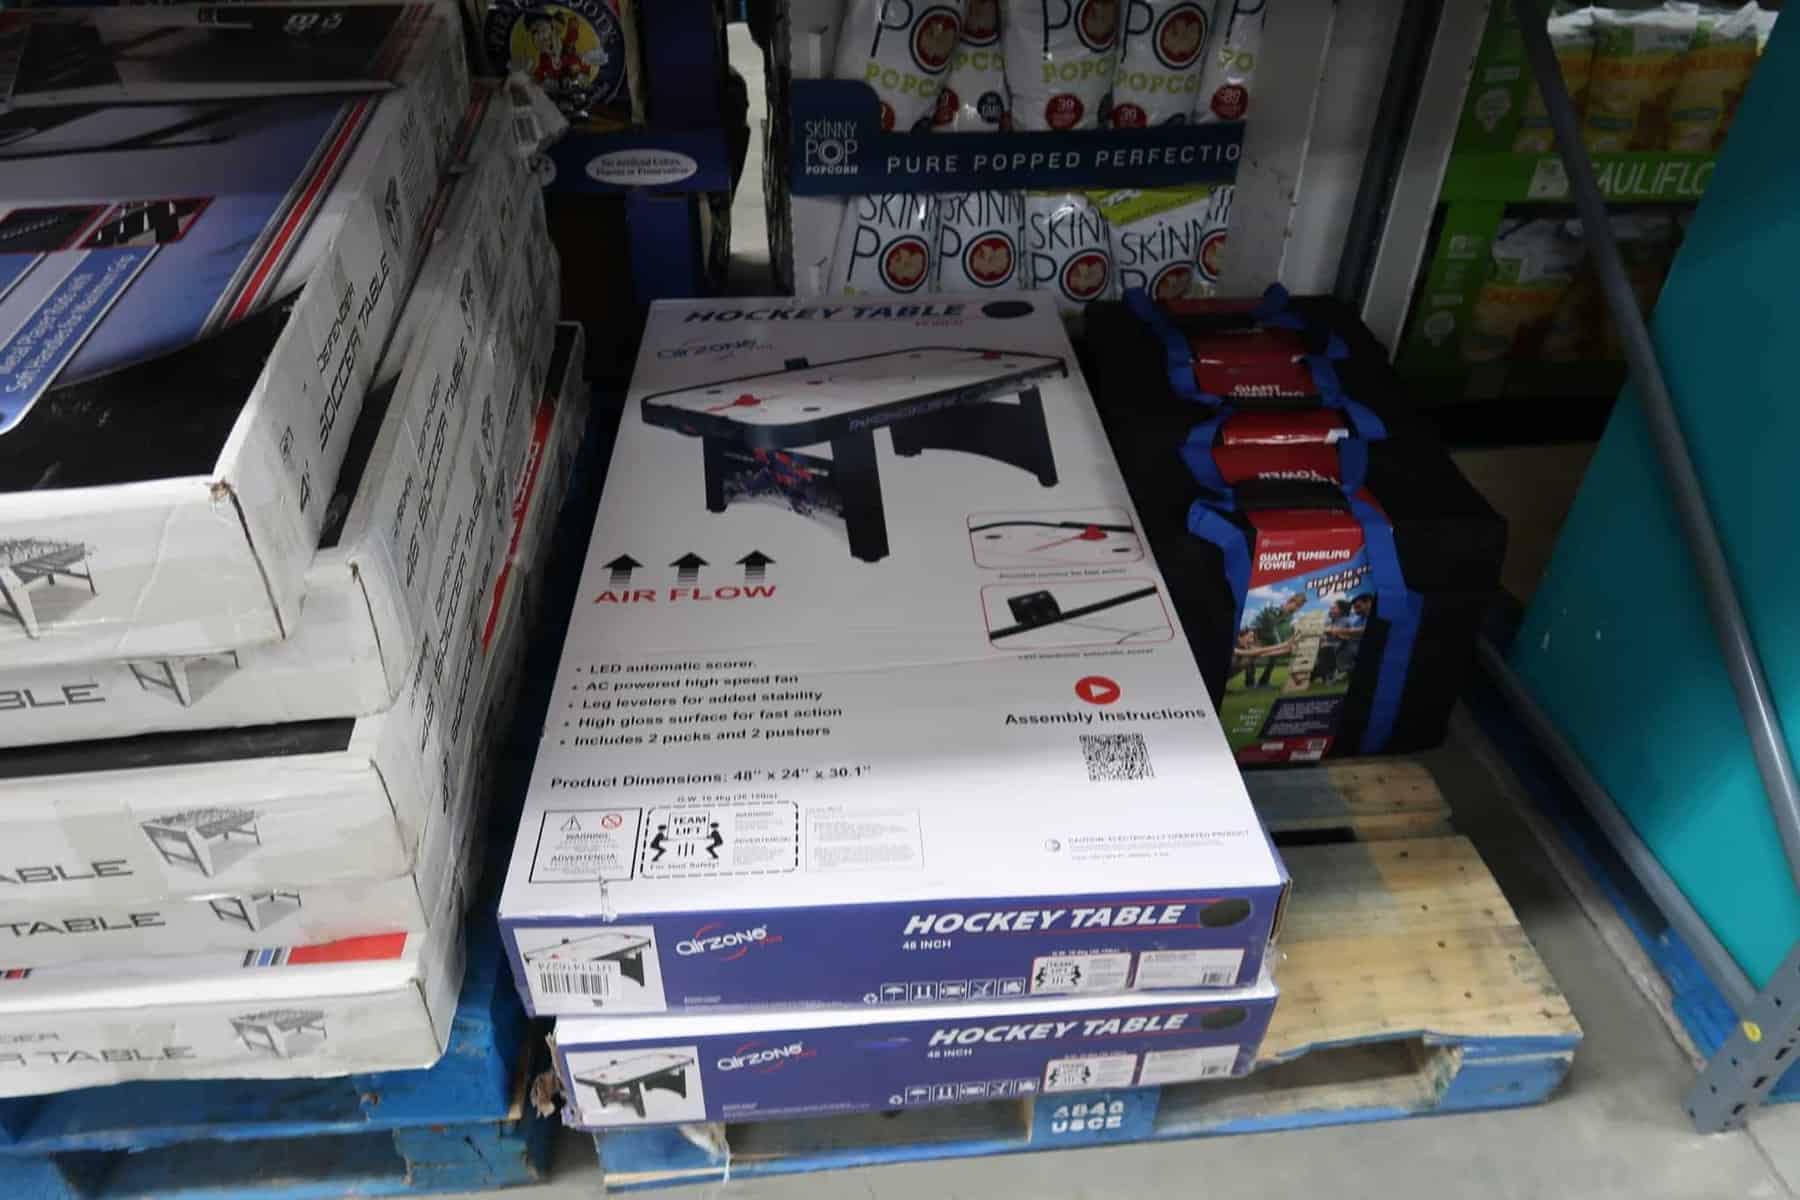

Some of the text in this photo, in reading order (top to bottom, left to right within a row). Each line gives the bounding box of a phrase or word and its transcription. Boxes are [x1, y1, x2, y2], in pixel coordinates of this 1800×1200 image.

[804, 115, 858, 139] SKINNY
[887, 143, 1241, 175] PURE POPPED PERFECTIO
[805, 166, 859, 175] POPCORN
[684, 303, 968, 323] HOCKEY TABLE
[319, 249, 391, 454] SOCCER TABLE
[1258, 560, 1296, 571] TOWER
[1259, 549, 1351, 562] GIANT TUMBLING
[594, 585, 777, 604] AIR FLOW
[590, 664, 622, 674] LED
[626, 661, 701, 673] automatic
[586, 674, 799, 694] AC powered high speed fan
[582, 690, 823, 711] Leg levelers for added stability
[578, 707, 843, 730] High gloss surface for fast action
[1006, 707, 1206, 726] Assembly Instructions
[574, 726, 831, 747] Includes 2 pucks and 2 pushers
[551, 774, 618, 790] Product
[623, 771, 729, 787] Dimensions:
[767, 772, 776, 782] x
[815, 770, 824, 781] x
[674, 815, 707, 825] TEAM
[675, 827, 702, 836] LIFT
[0, 912, 166, 937] TABLE
[903, 904, 1186, 936] HOCKEY TABLE
[919, 939, 952, 951] INCH
[927, 1013, 1188, 1047] HOCKEY TABLE
[34, 1045, 196, 1064] TABLE
[944, 1047, 973, 1058] INCH
